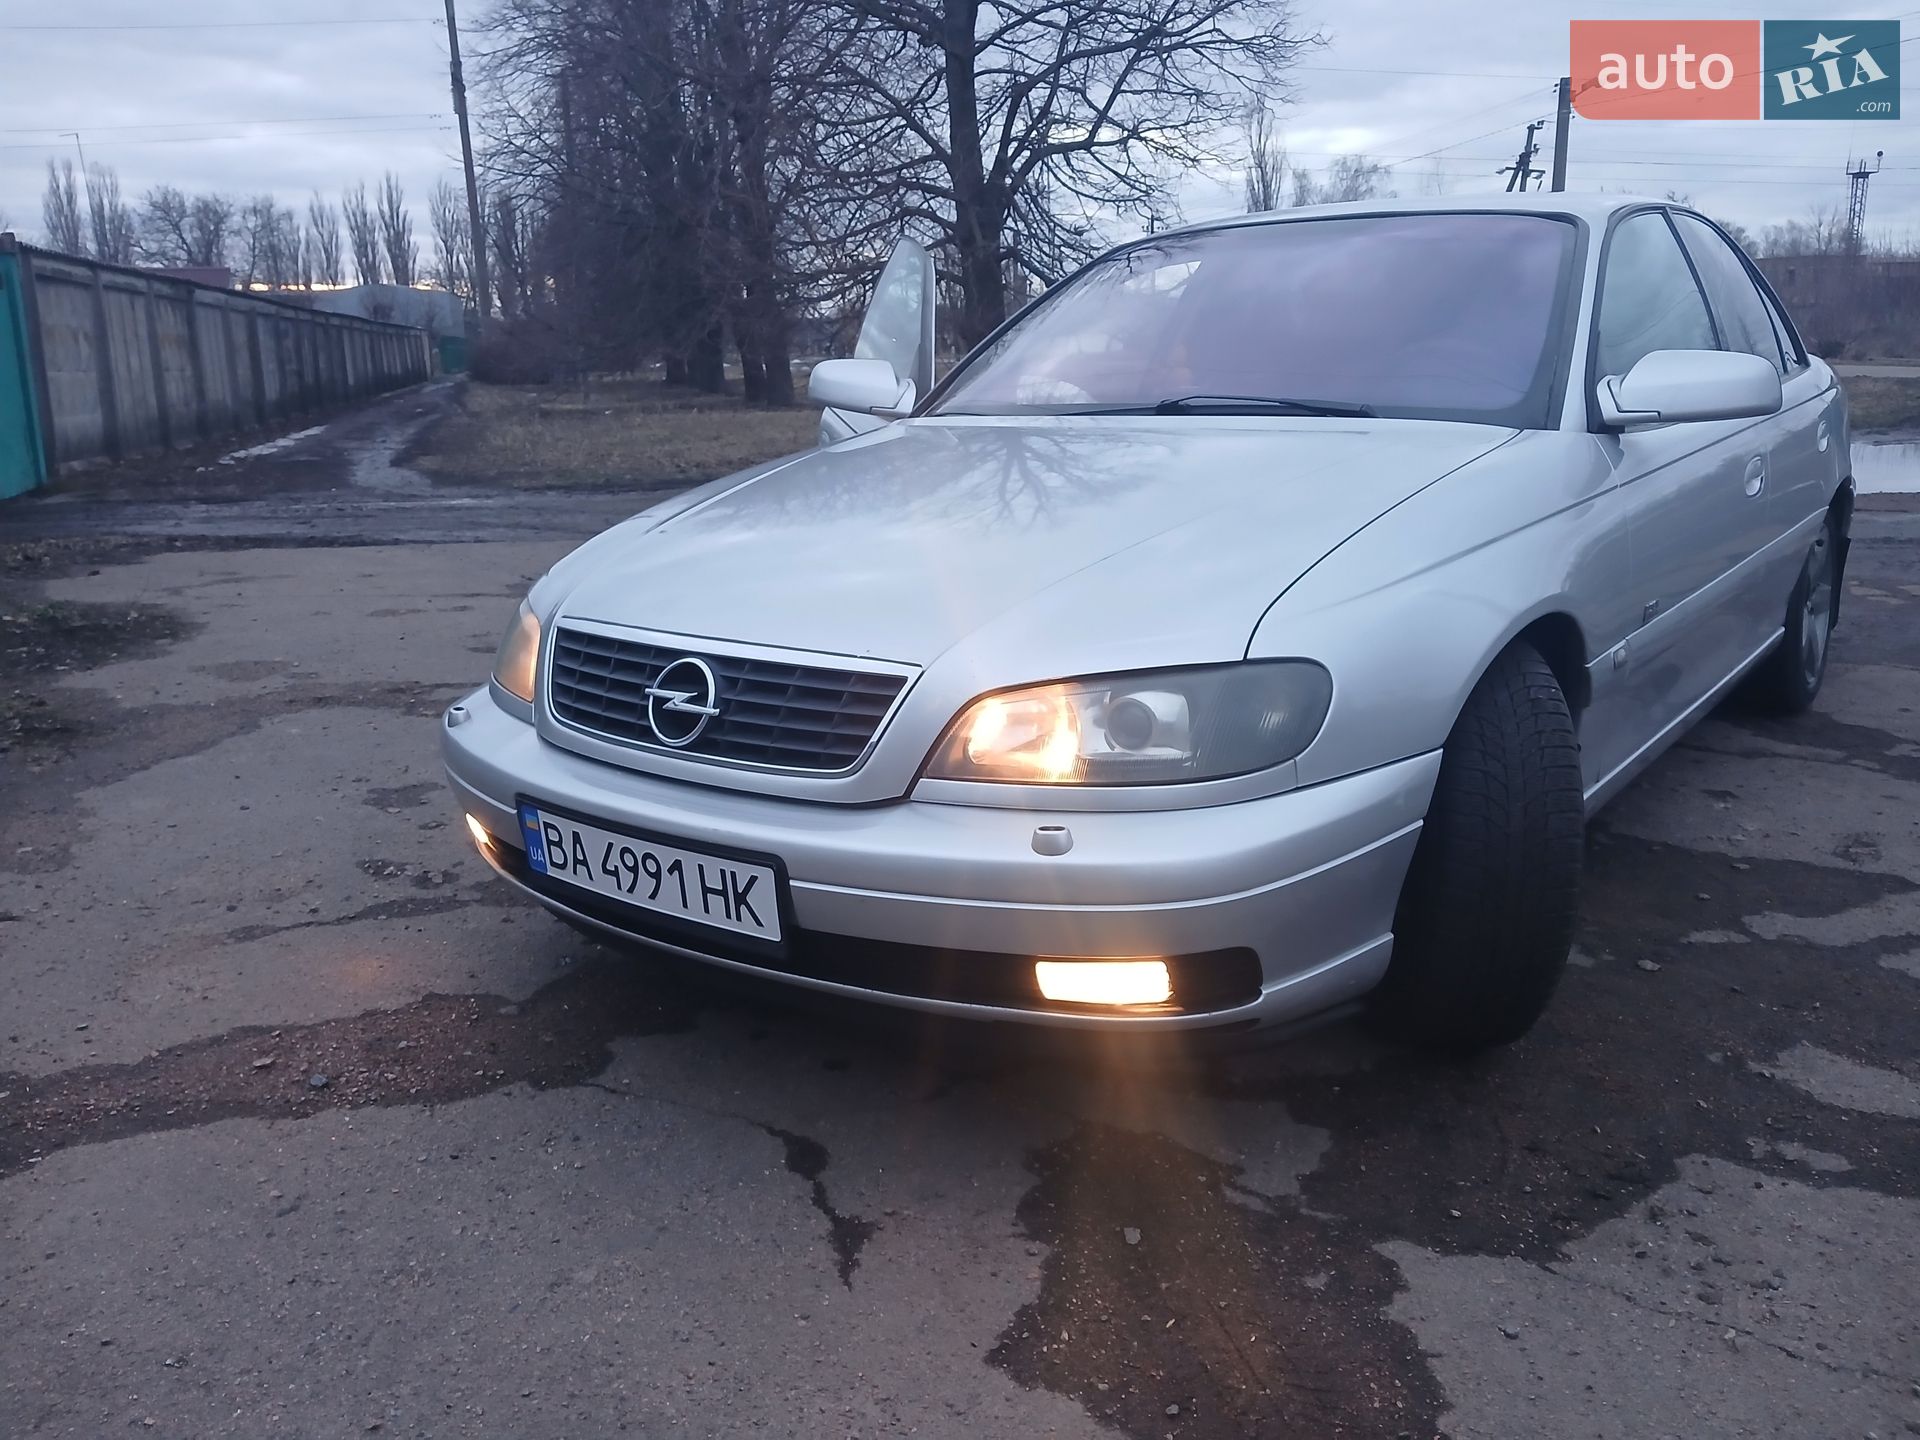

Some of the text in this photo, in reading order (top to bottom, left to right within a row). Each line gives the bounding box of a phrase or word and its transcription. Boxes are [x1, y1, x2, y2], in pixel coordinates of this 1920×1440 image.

[529, 845, 546, 864] UA
[542, 820, 766, 928] BA 4991 HK
